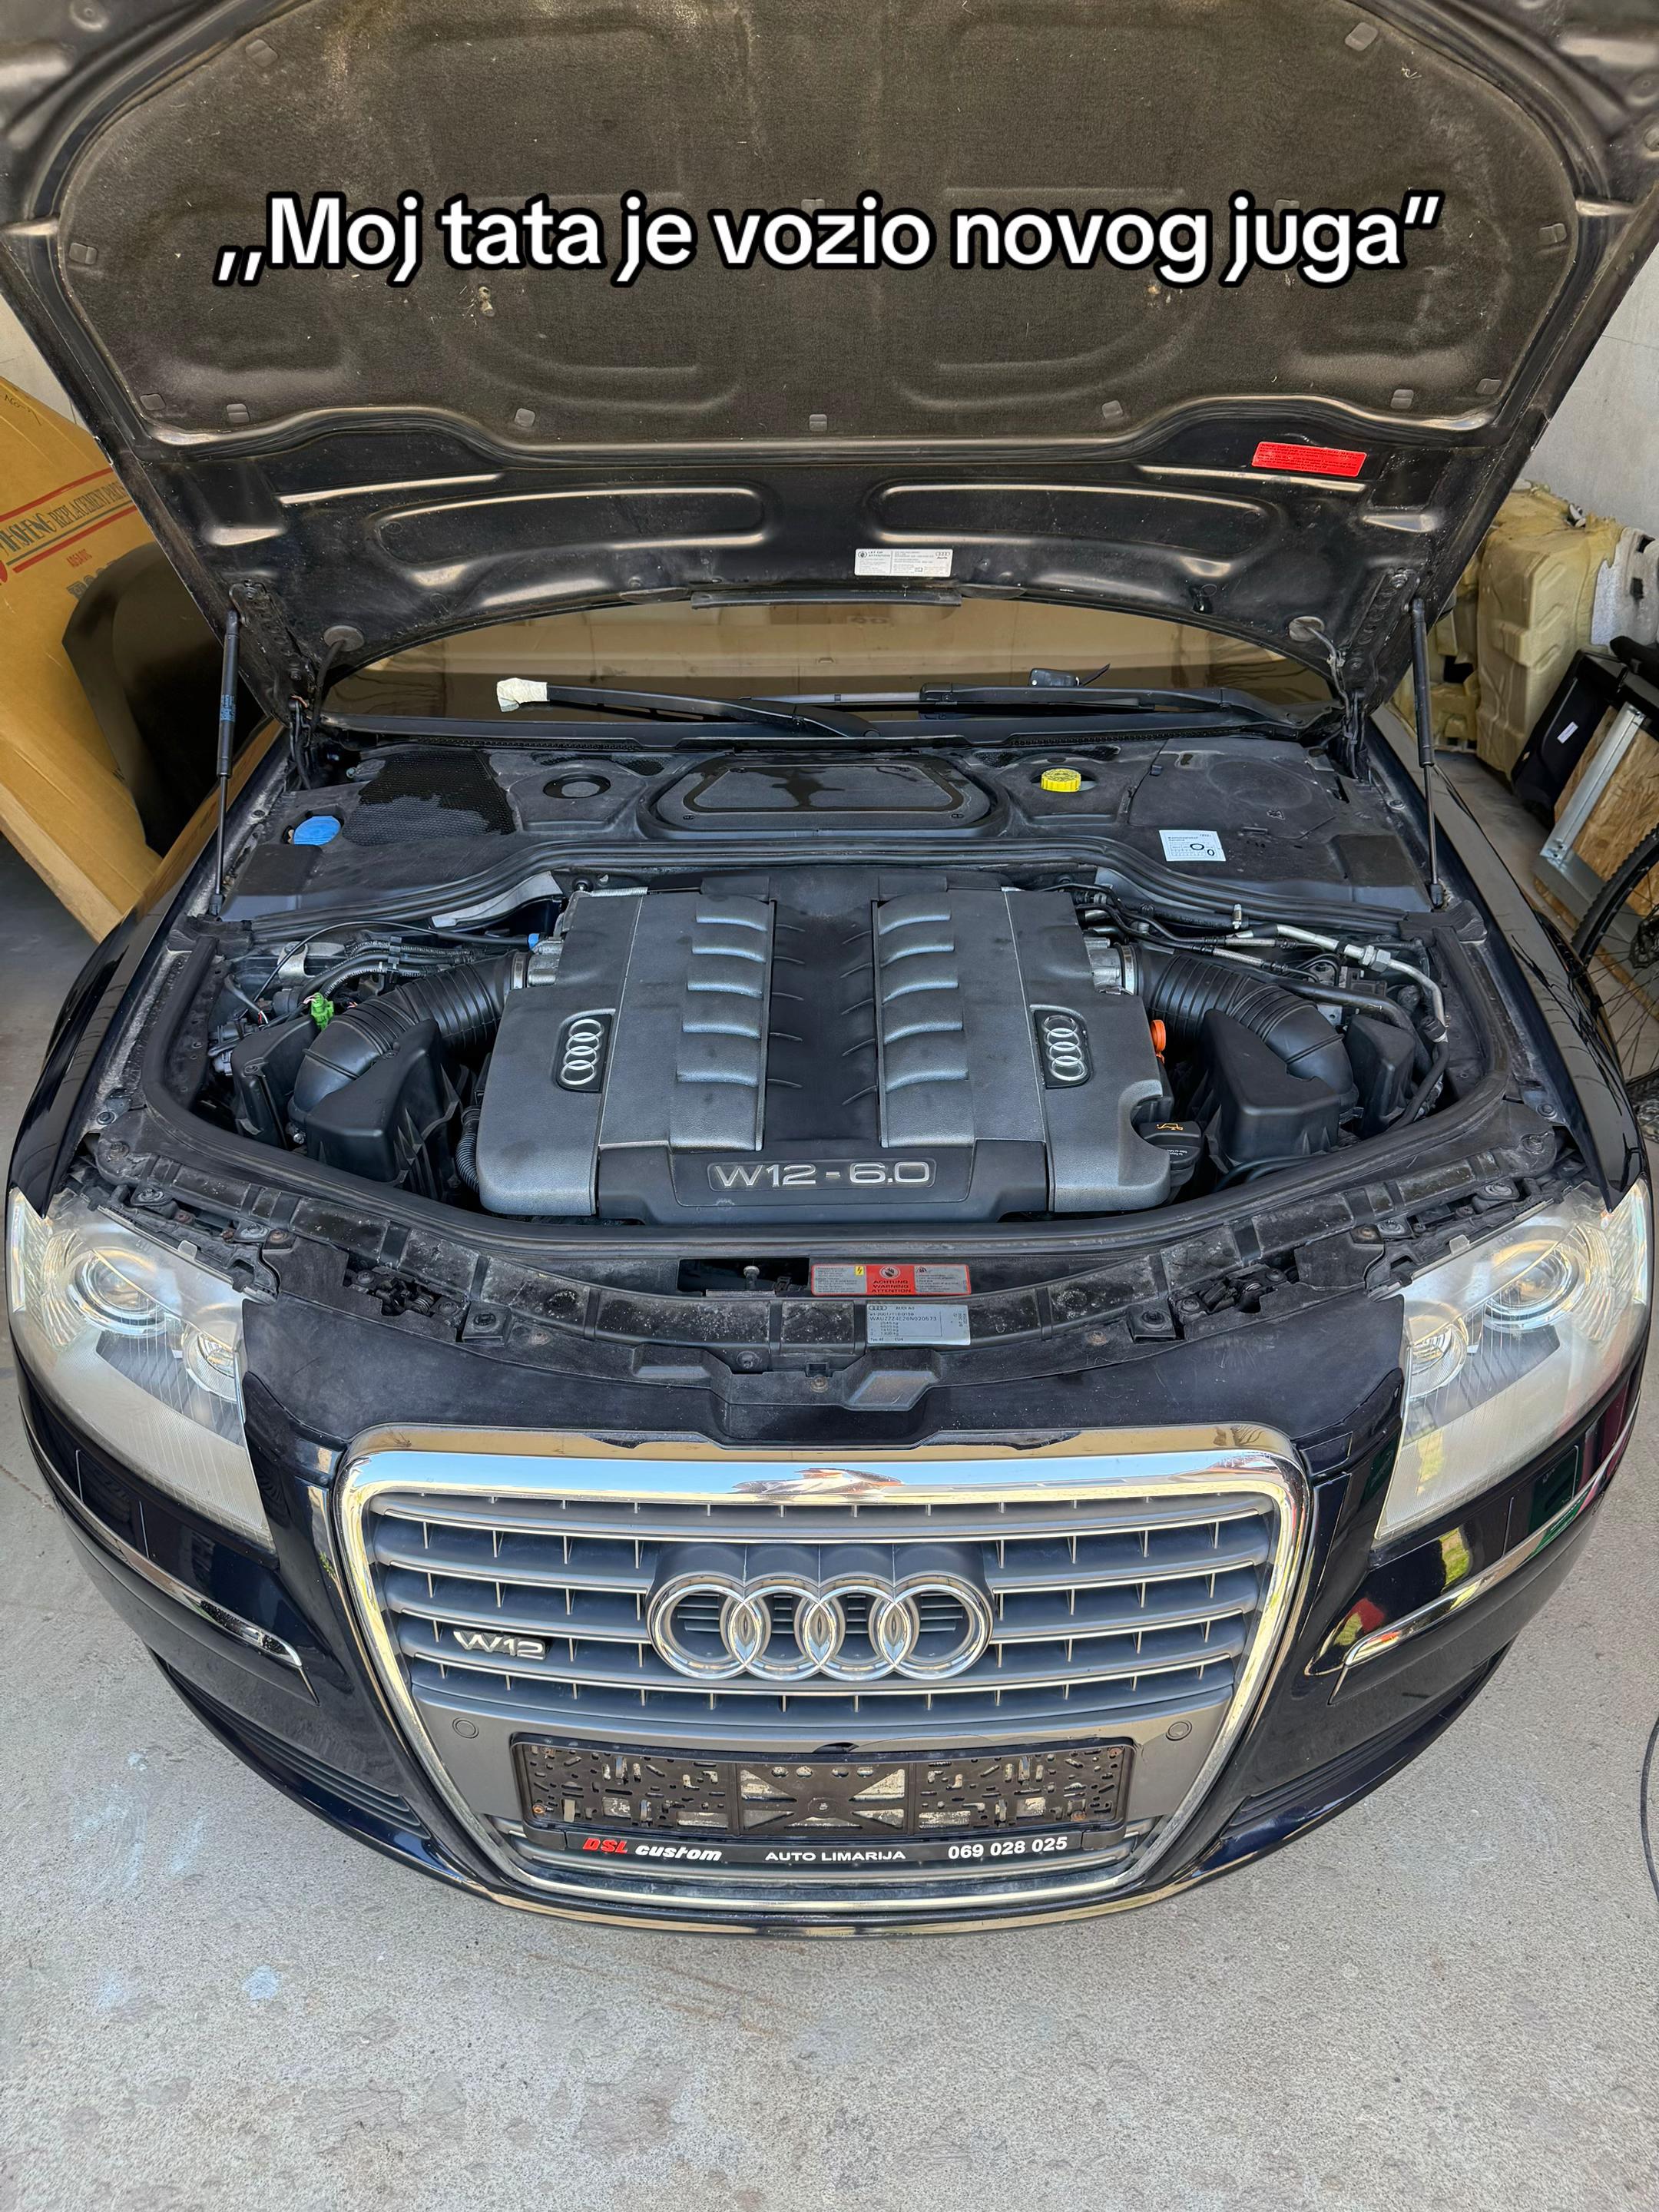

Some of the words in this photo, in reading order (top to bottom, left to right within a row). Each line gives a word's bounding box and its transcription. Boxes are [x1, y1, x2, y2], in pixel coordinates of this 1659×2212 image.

[452, 1629, 545, 1661] W12
[582, 1837, 628, 1854] DSL
[635, 1845, 723, 1862] custom
[764, 1852, 816, 1862] AUTO
[821, 1850, 906, 1862] LIMARIJA
[948, 1844, 985, 1859] 069
[990, 1840, 1026, 1856] 028
[1031, 1836, 1068, 1853] 025
